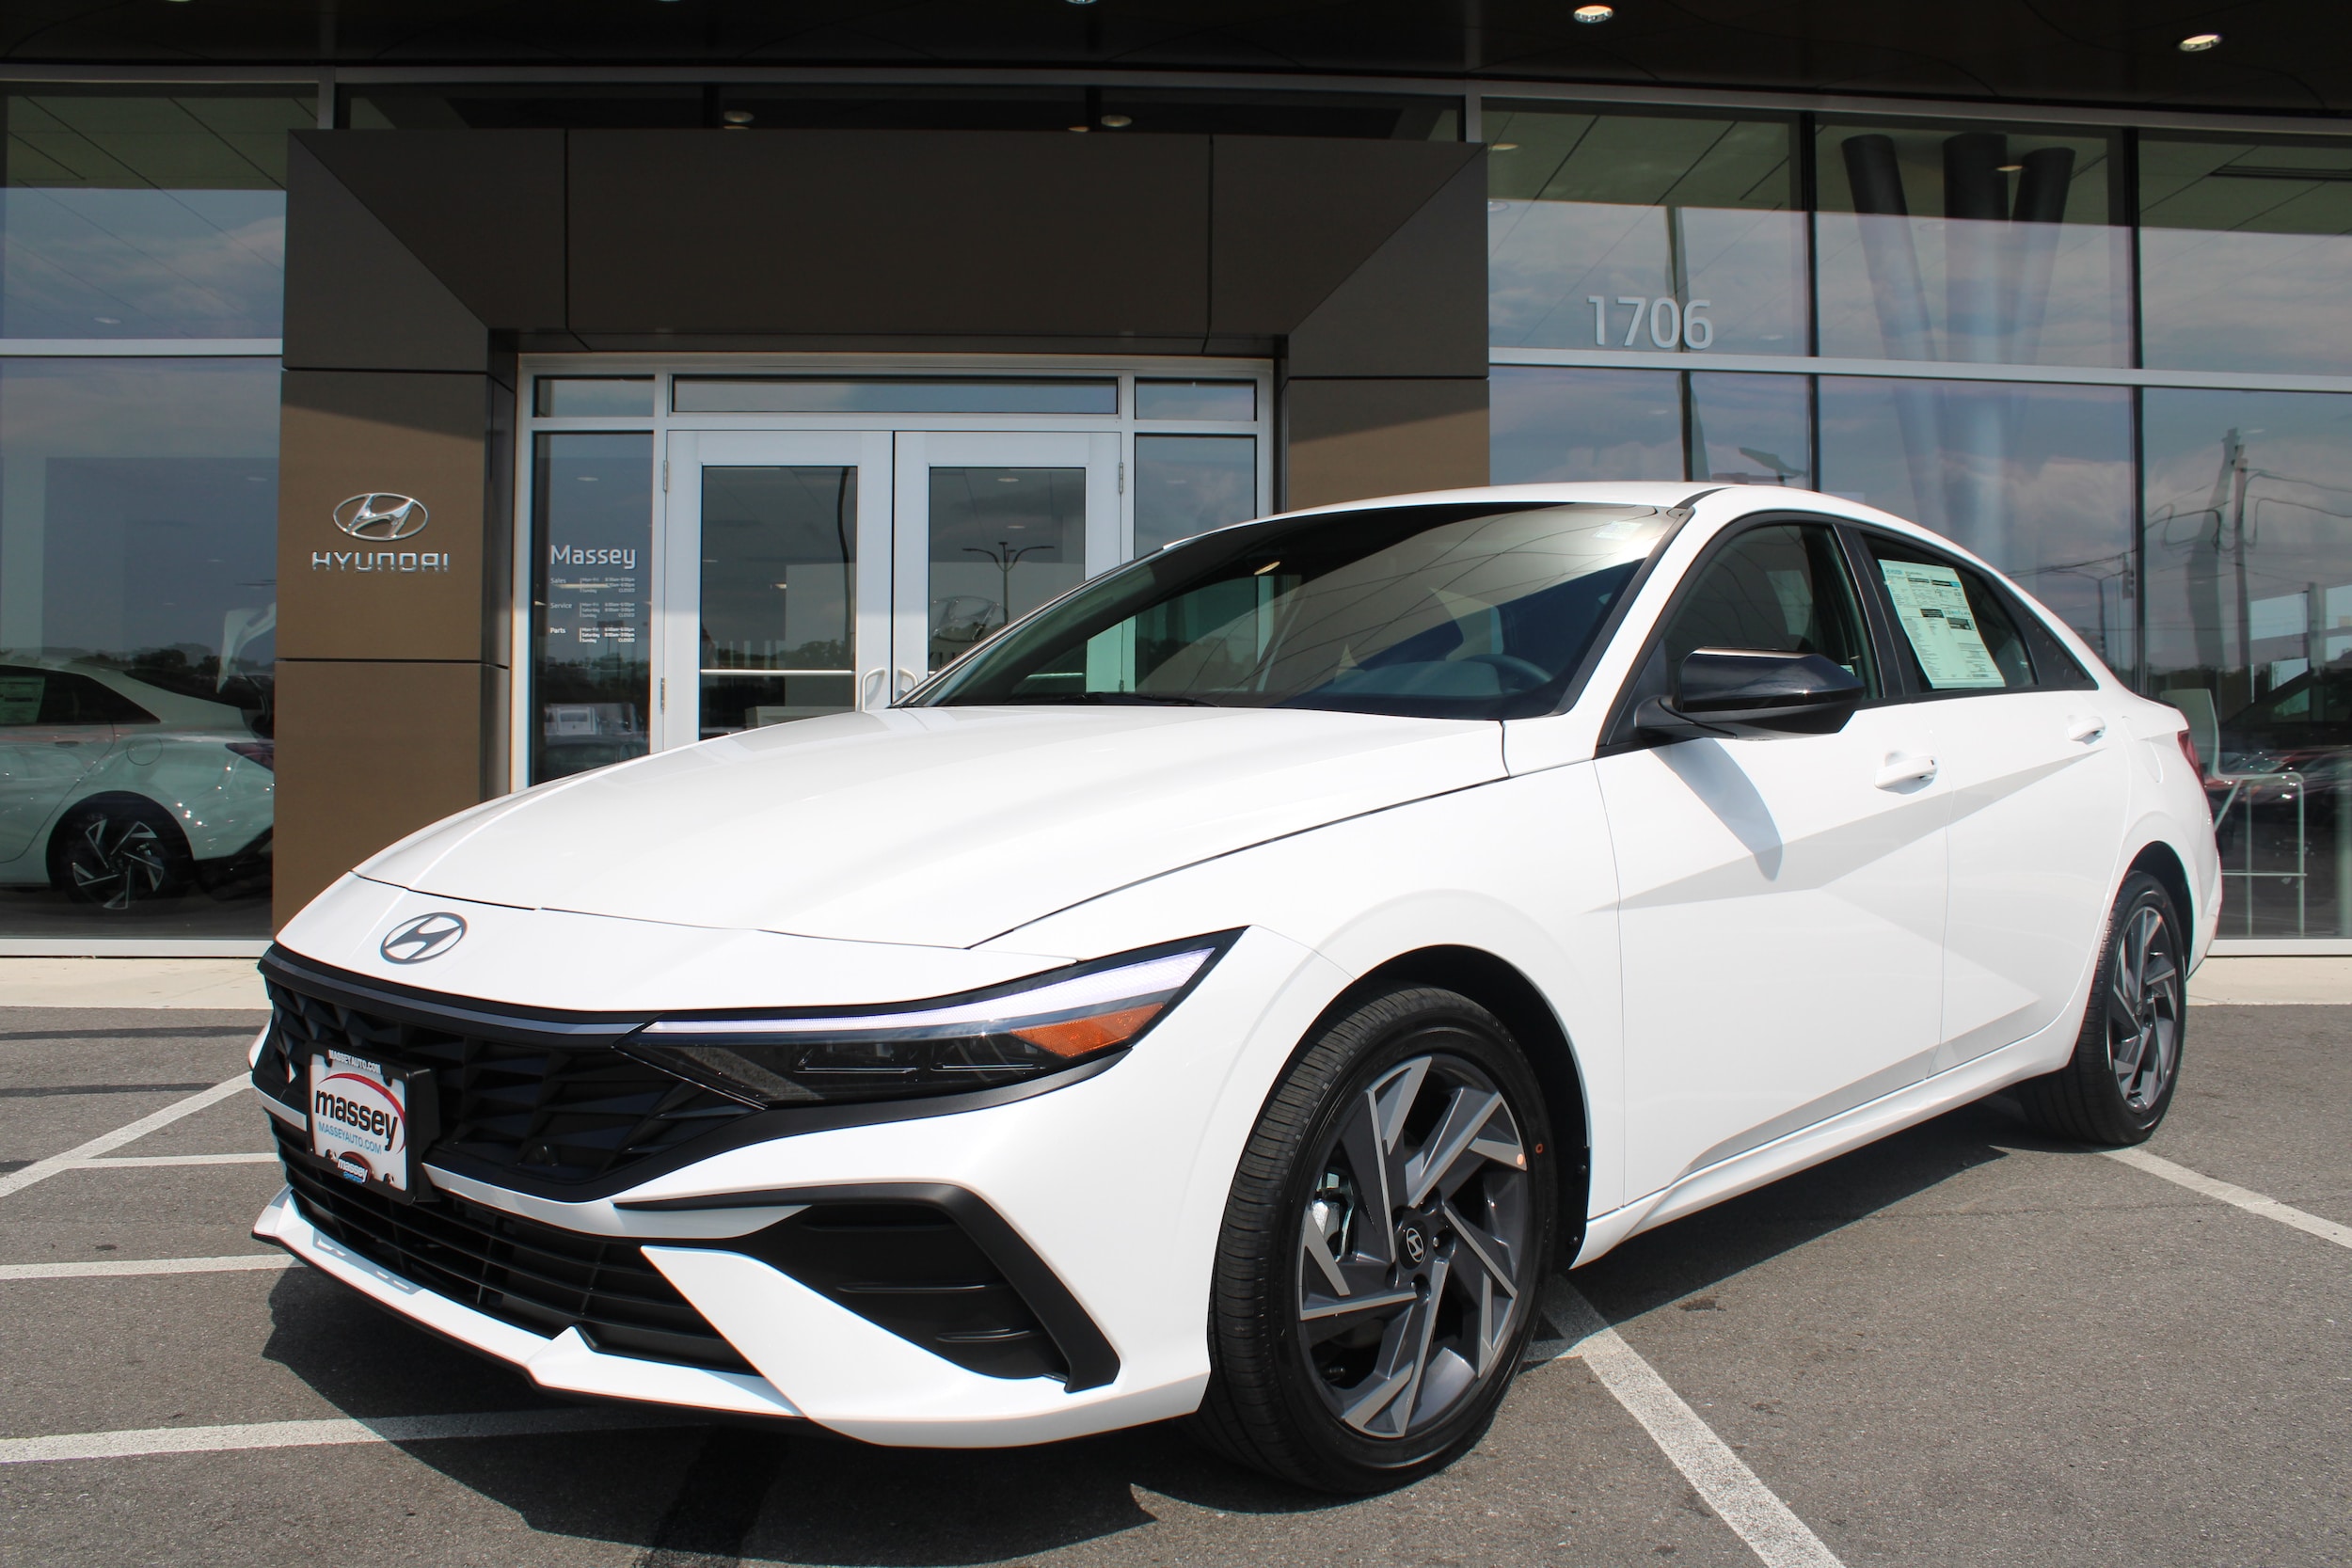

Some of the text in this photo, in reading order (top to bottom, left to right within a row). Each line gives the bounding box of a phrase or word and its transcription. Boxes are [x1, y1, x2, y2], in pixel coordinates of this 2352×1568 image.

[1588, 295, 1713, 350] 1706
[311, 551, 450, 573] HYUNDAI
[550, 545, 636, 570] Massey
[328, 1049, 381, 1074] MASSEYAUTO.COM
[315, 1090, 399, 1152] massey
[318, 1121, 382, 1155] MASSEYAUTO.COM
[338, 1158, 368, 1182] massey
